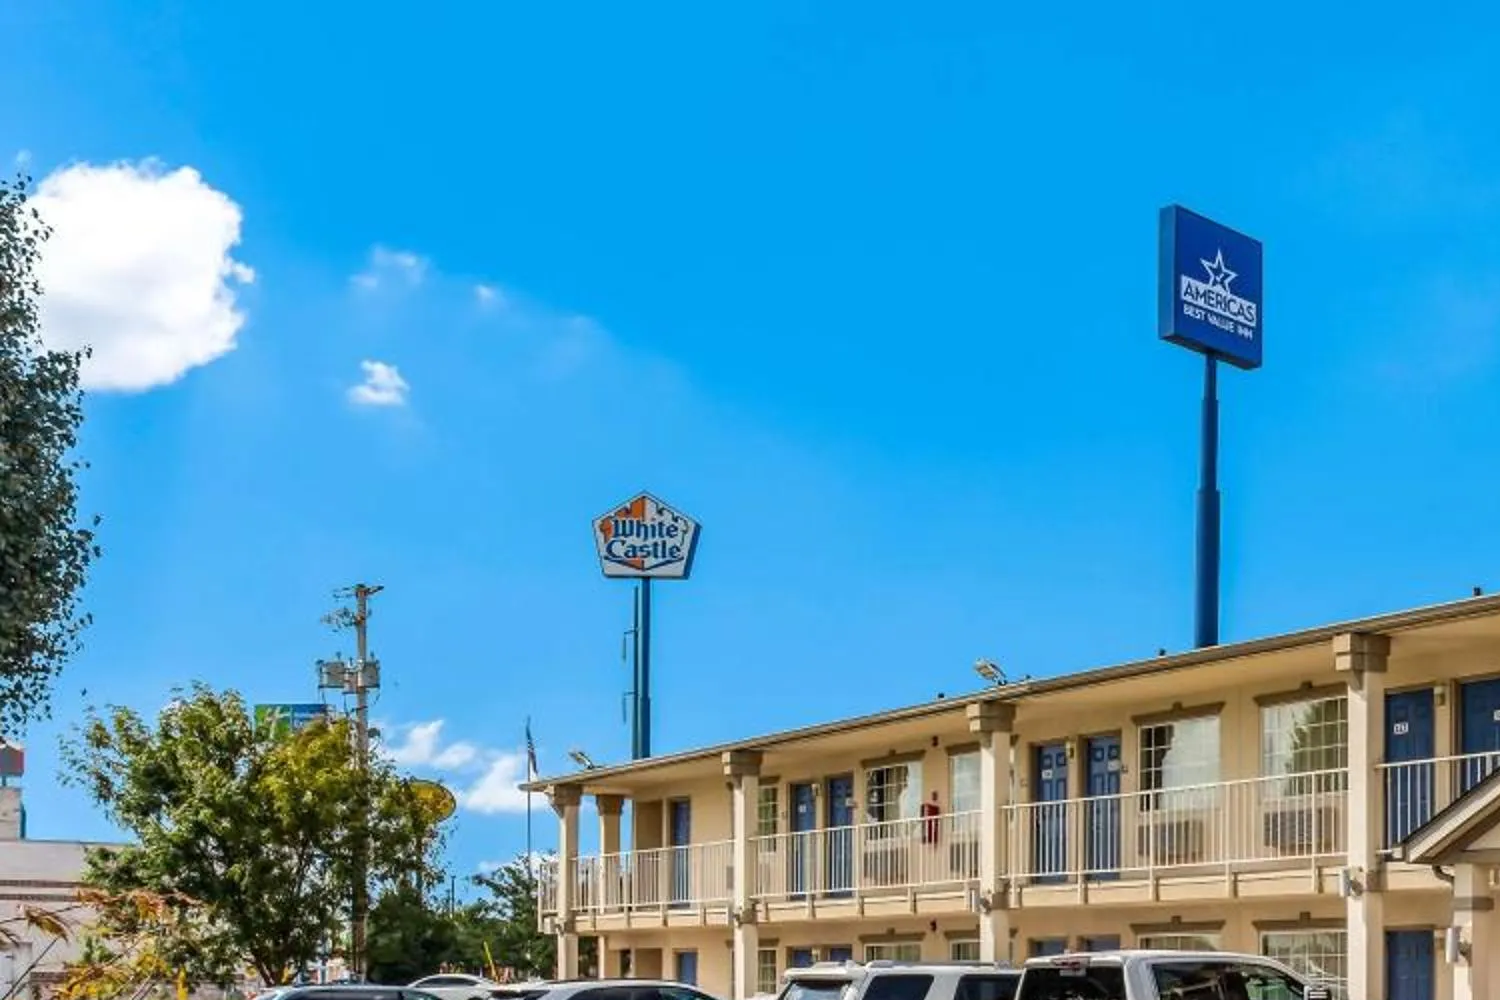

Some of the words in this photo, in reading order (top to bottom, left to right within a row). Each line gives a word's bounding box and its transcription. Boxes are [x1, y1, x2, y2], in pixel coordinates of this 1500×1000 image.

[1183, 303, 1205, 320] BEST
[1184, 280, 1255, 323] AMERICAS
[613, 518, 679, 540] White
[606, 539, 681, 559] Castle
